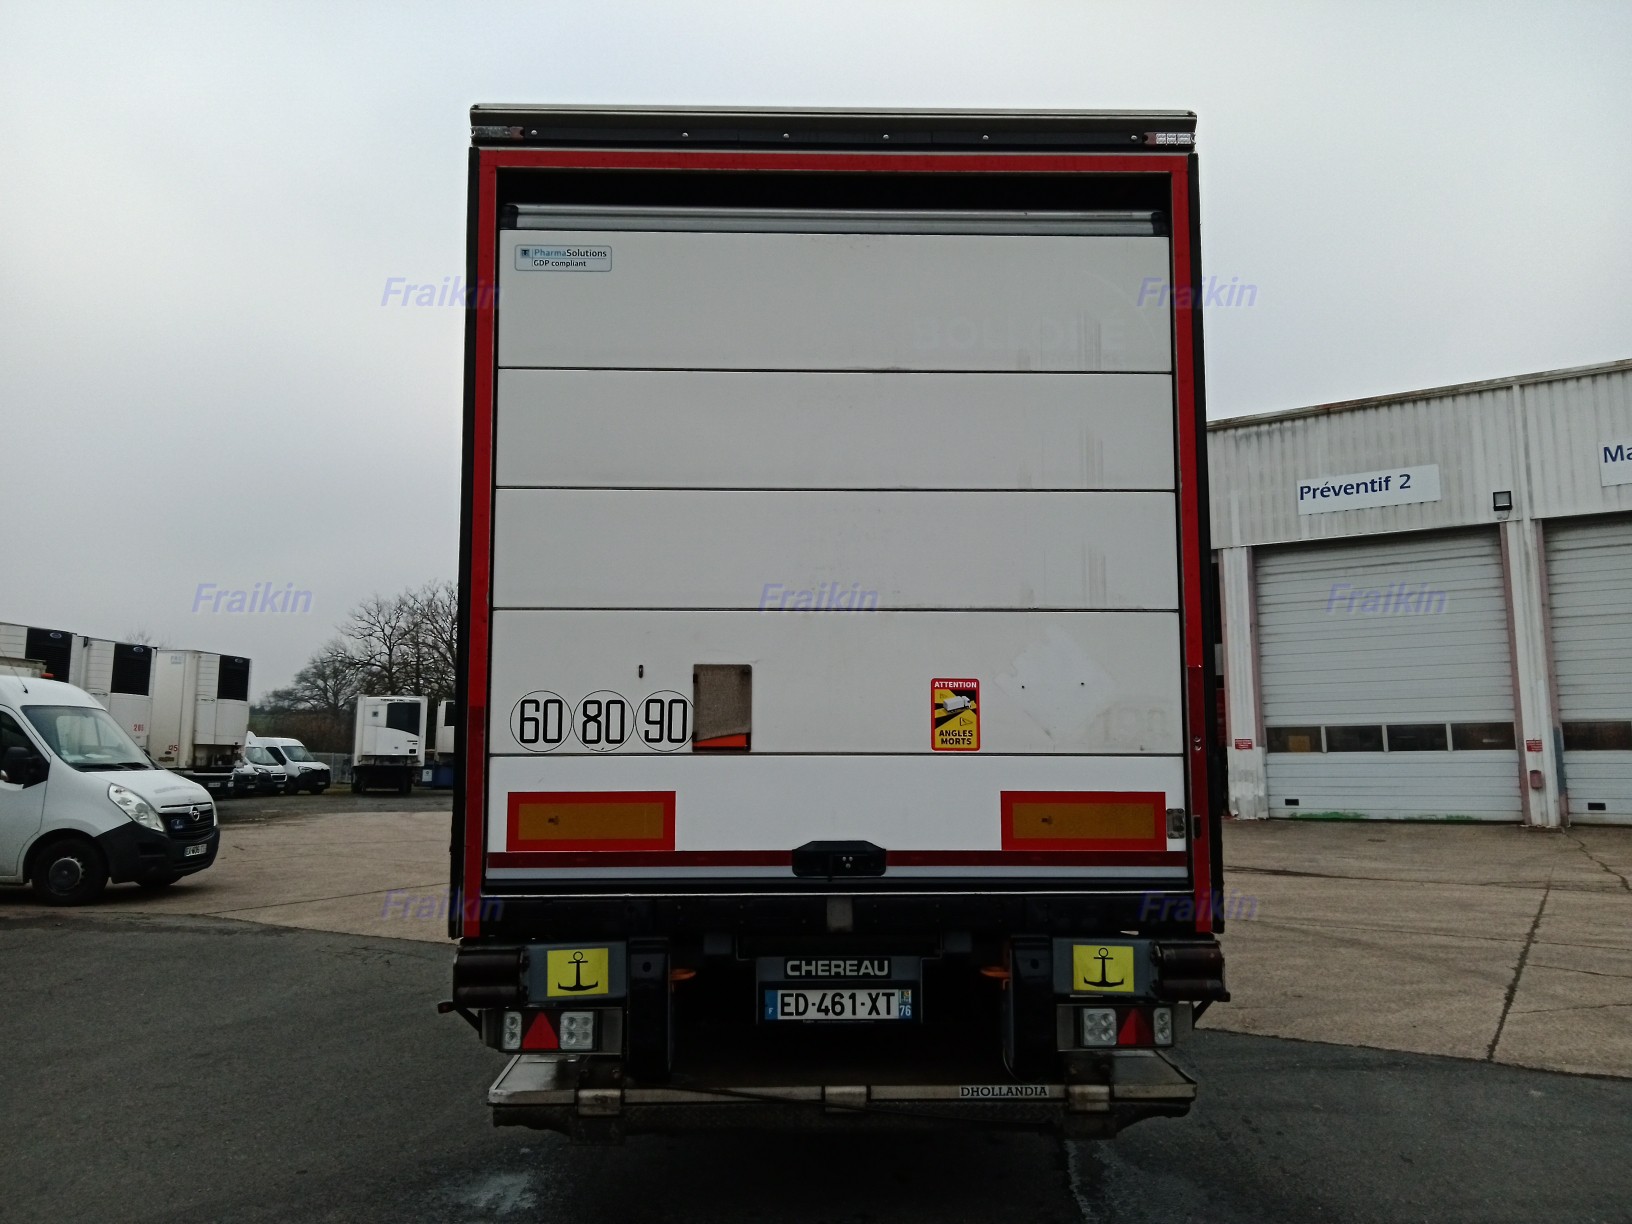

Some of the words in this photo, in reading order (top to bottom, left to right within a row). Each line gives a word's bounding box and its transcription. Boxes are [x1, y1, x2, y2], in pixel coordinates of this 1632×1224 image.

[534, 249, 607, 258] PharmaSolutions
[551, 260, 587, 268] compliant
[1300, 475, 1392, 500] Préventif
[1399, 473, 1411, 489] 2
[519, 699, 563, 744] 60
[582, 700, 625, 744] 80
[644, 699, 688, 743] 90
[939, 729, 973, 737] ANGLES
[786, 960, 889, 976] CHEREAU
[768, 1007, 773, 1015] F
[780, 992, 896, 1016] ED-461-XT
[899, 1004, 912, 1017] 76
[961, 1087, 1048, 1097] DHOLLANDIA
